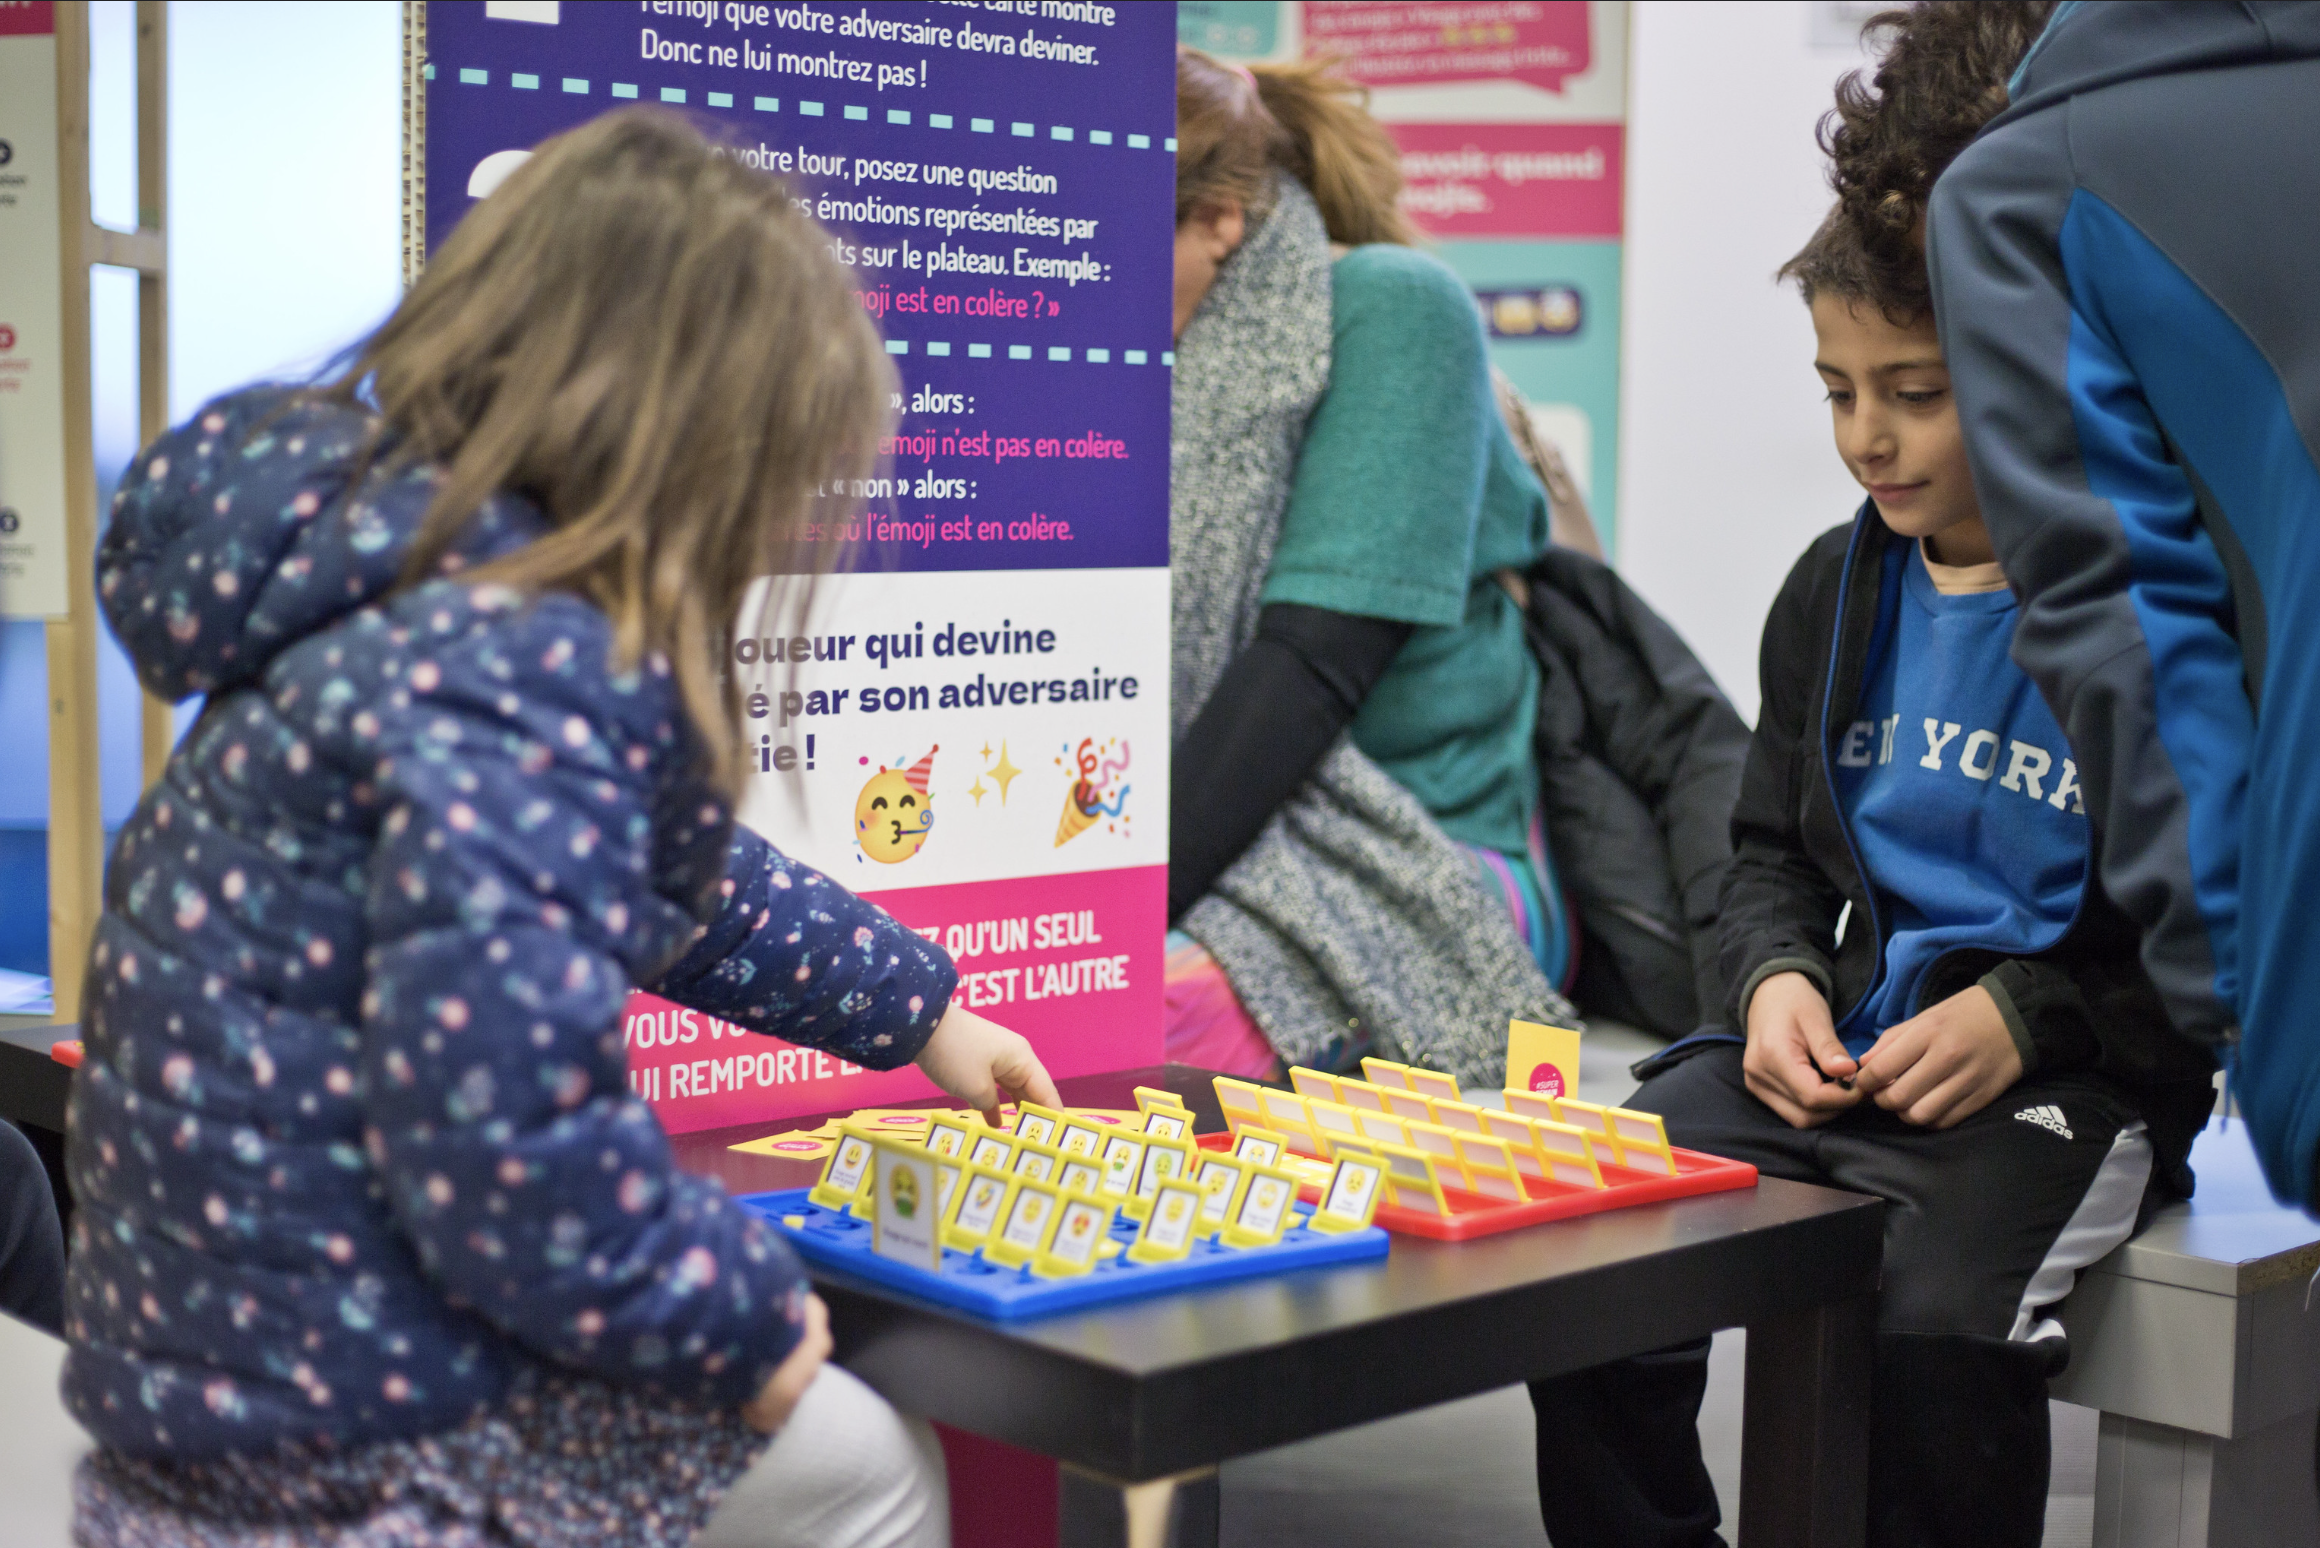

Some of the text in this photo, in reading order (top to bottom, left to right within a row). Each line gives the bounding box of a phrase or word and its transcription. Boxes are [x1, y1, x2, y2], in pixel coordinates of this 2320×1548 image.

[641, 1, 1100, 66] moji que votre adversaire devra deviner.
[1041, 1, 1116, 27] montre
[641, 28, 927, 92] Donc ne lui montrez pas !
[733, 142, 793, 173] votre
[798, 145, 849, 180] tour,
[855, 158, 919, 187] posez
[923, 164, 964, 187] une
[968, 165, 1057, 196] question
[817, 191, 921, 226] émotions
[925, 203, 1061, 237] représentées
[1063, 218, 1099, 245] par
[861, 245, 898, 268] sur
[902, 239, 922, 270] le
[926, 241, 1010, 279] plateau.
[895, 286, 929, 313] est
[933, 293, 960, 314] en
[965, 287, 1029, 318] colère
[911, 383, 965, 414] alors
[942, 427, 991, 457] n'est
[995, 437, 1031, 464] pas
[1035, 438, 1061, 458] en
[1064, 429, 1130, 460] colère.
[851, 478, 893, 499] non
[913, 468, 967, 499] alors
[867, 512, 936, 549] l'émoji
[940, 514, 973, 541] est
[977, 521, 1003, 541] en
[1008, 512, 1075, 541] colère.
[735, 618, 1056, 669] oueur qui devine
[778, 689, 850, 728] par
[859, 684, 930, 713] son
[938, 667, 1139, 709] adversaire
[946, 909, 1102, 963] QU'UN SEUL
[1025, 954, 1130, 1001] L'AUTRE
[630, 1047, 834, 1102] UI REMPORTE
[2014, 1112, 2074, 1140] adidas
